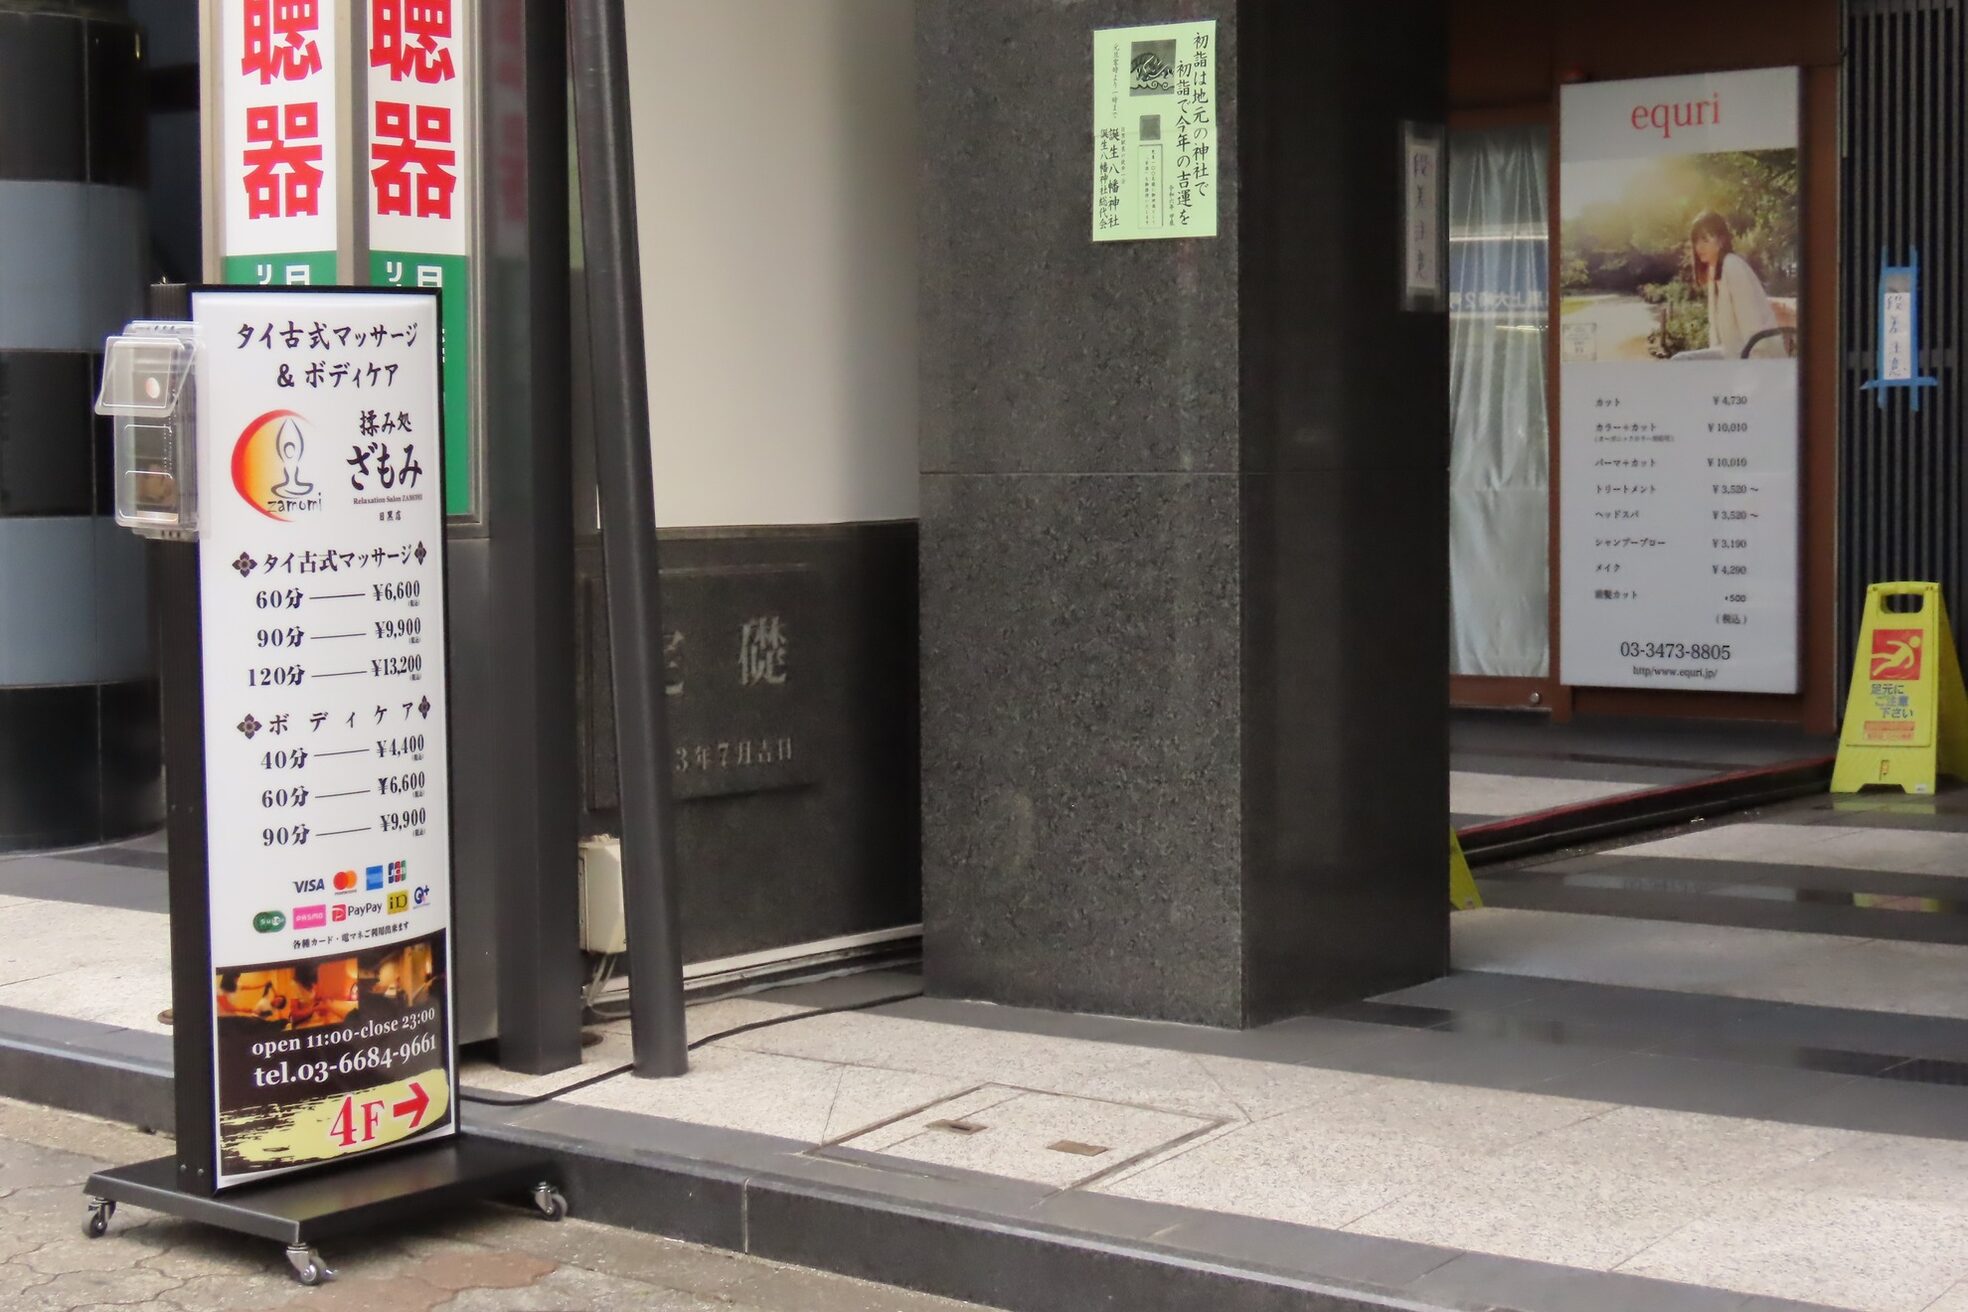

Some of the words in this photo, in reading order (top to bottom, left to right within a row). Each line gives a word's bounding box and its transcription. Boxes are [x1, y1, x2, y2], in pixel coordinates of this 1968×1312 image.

[1192, 32, 1210, 197] 初詣は地元の神社で
[1631, 92, 1721, 138] equri
[1175, 60, 1192, 226] 初詣で今年の吉運を
[1108, 127, 1120, 228] 誕生八幡神社
[237, 320, 418, 350] タイ古式マッサージ
[277, 363, 295, 387] &
[305, 360, 399, 388] ボディケア
[1596, 397, 1620, 407] カット
[359, 410, 413, 437] 揉み処
[346, 441, 423, 491] ざもみ
[353, 496, 385, 505] Relaxation
[1596, 484, 1656, 494] トリートメント
[263, 543, 413, 575] タイ古式マッサージ
[1595, 563, 1621, 573] メイク
[256, 587, 304, 610] 60分
[372, 580, 421, 602] ¥6,600
[257, 625, 305, 648] 90分
[374, 617, 421, 640] ¥9,900
[1620, 641, 1731, 661] 03-3473-8805
[248, 664, 305, 687] 120分
[371, 654, 422, 677] ¥13,200
[269, 702, 413, 735] ボディケア
[260, 747, 308, 770] 40分
[377, 734, 425, 758] ¥4,400
[261, 785, 309, 809] 60分
[378, 771, 425, 795] ¥6,600
[262, 824, 310, 847] 90分
[380, 807, 426, 832] ¥9,900
[292, 877, 325, 894] VISA
[348, 902, 382, 917] PayPay
[252, 1037, 300, 1059] open
[402, 1008, 435, 1031] 23:00
[254, 1033, 436, 1087] tel.03-6684-9661
[330, 1095, 385, 1147] 4F
